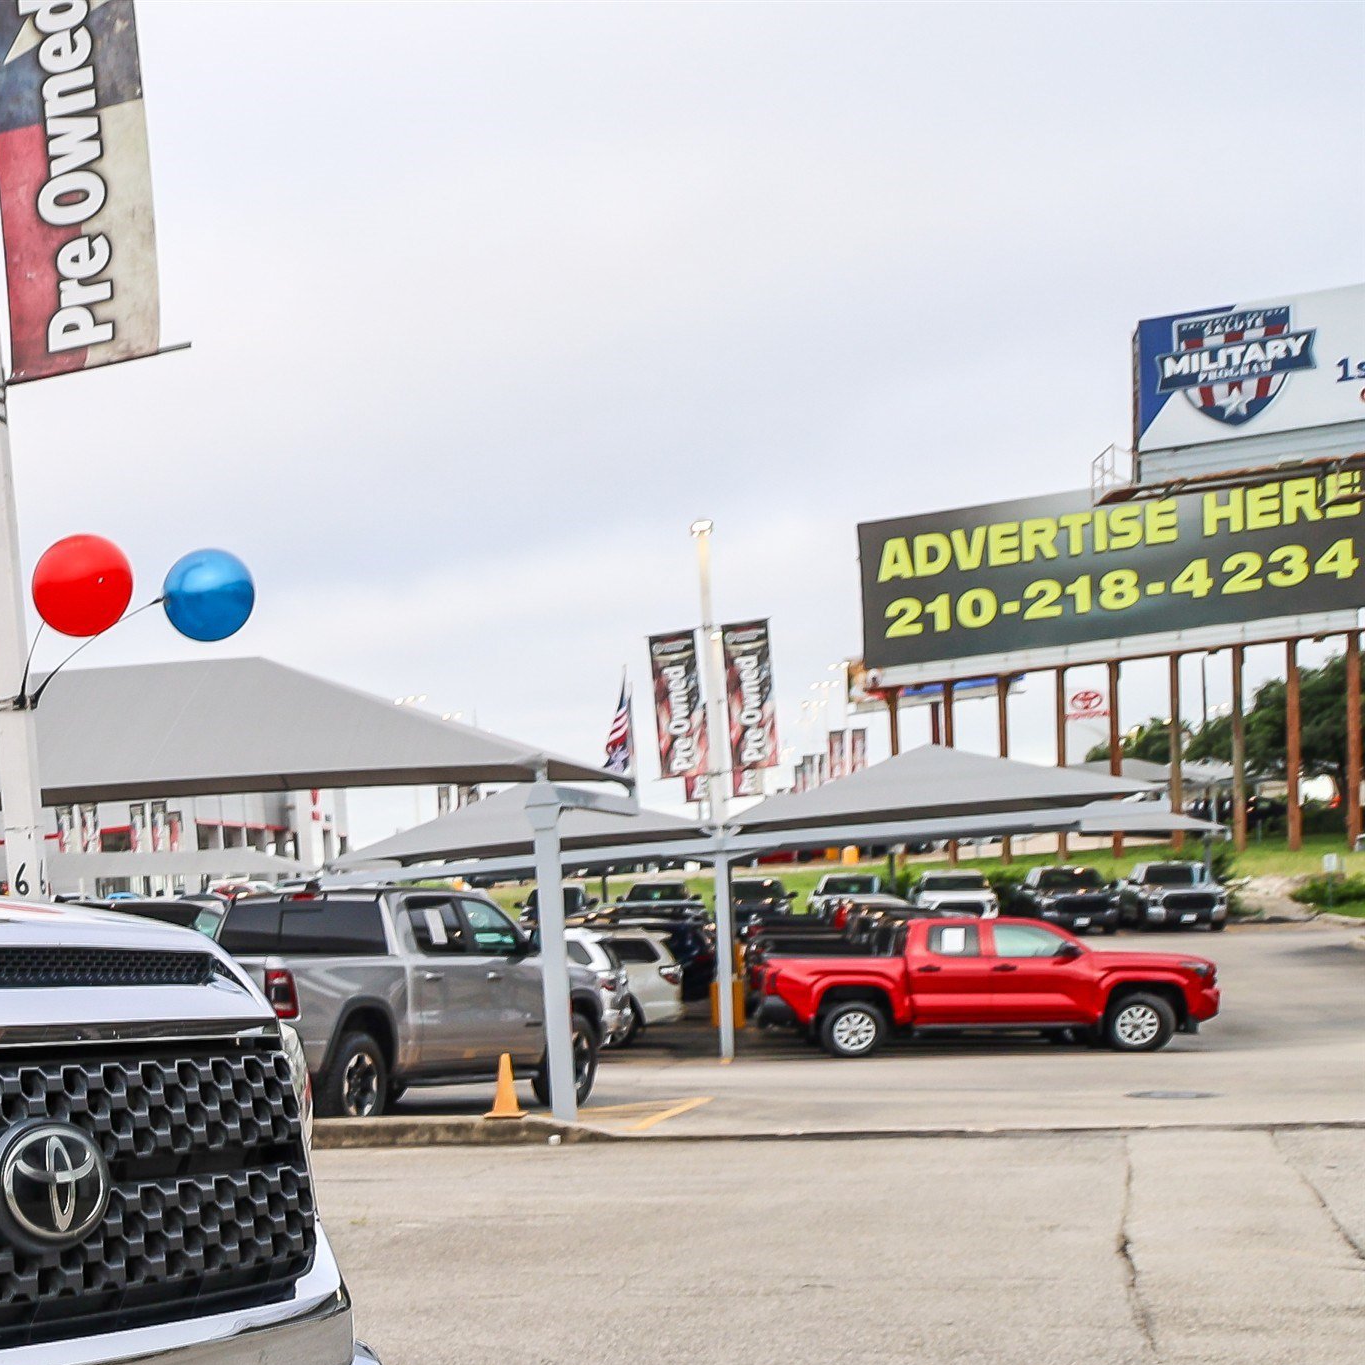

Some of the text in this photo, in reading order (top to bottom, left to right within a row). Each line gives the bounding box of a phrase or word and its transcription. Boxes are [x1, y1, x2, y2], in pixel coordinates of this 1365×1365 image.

[46, 233, 114, 353] Pre
[1163, 333, 1309, 379] MILITARY
[877, 469, 1362, 584] ADVERTISE HERE
[884, 537, 1360, 639] 210-218-4234
[15, 862, 29, 896] 6
